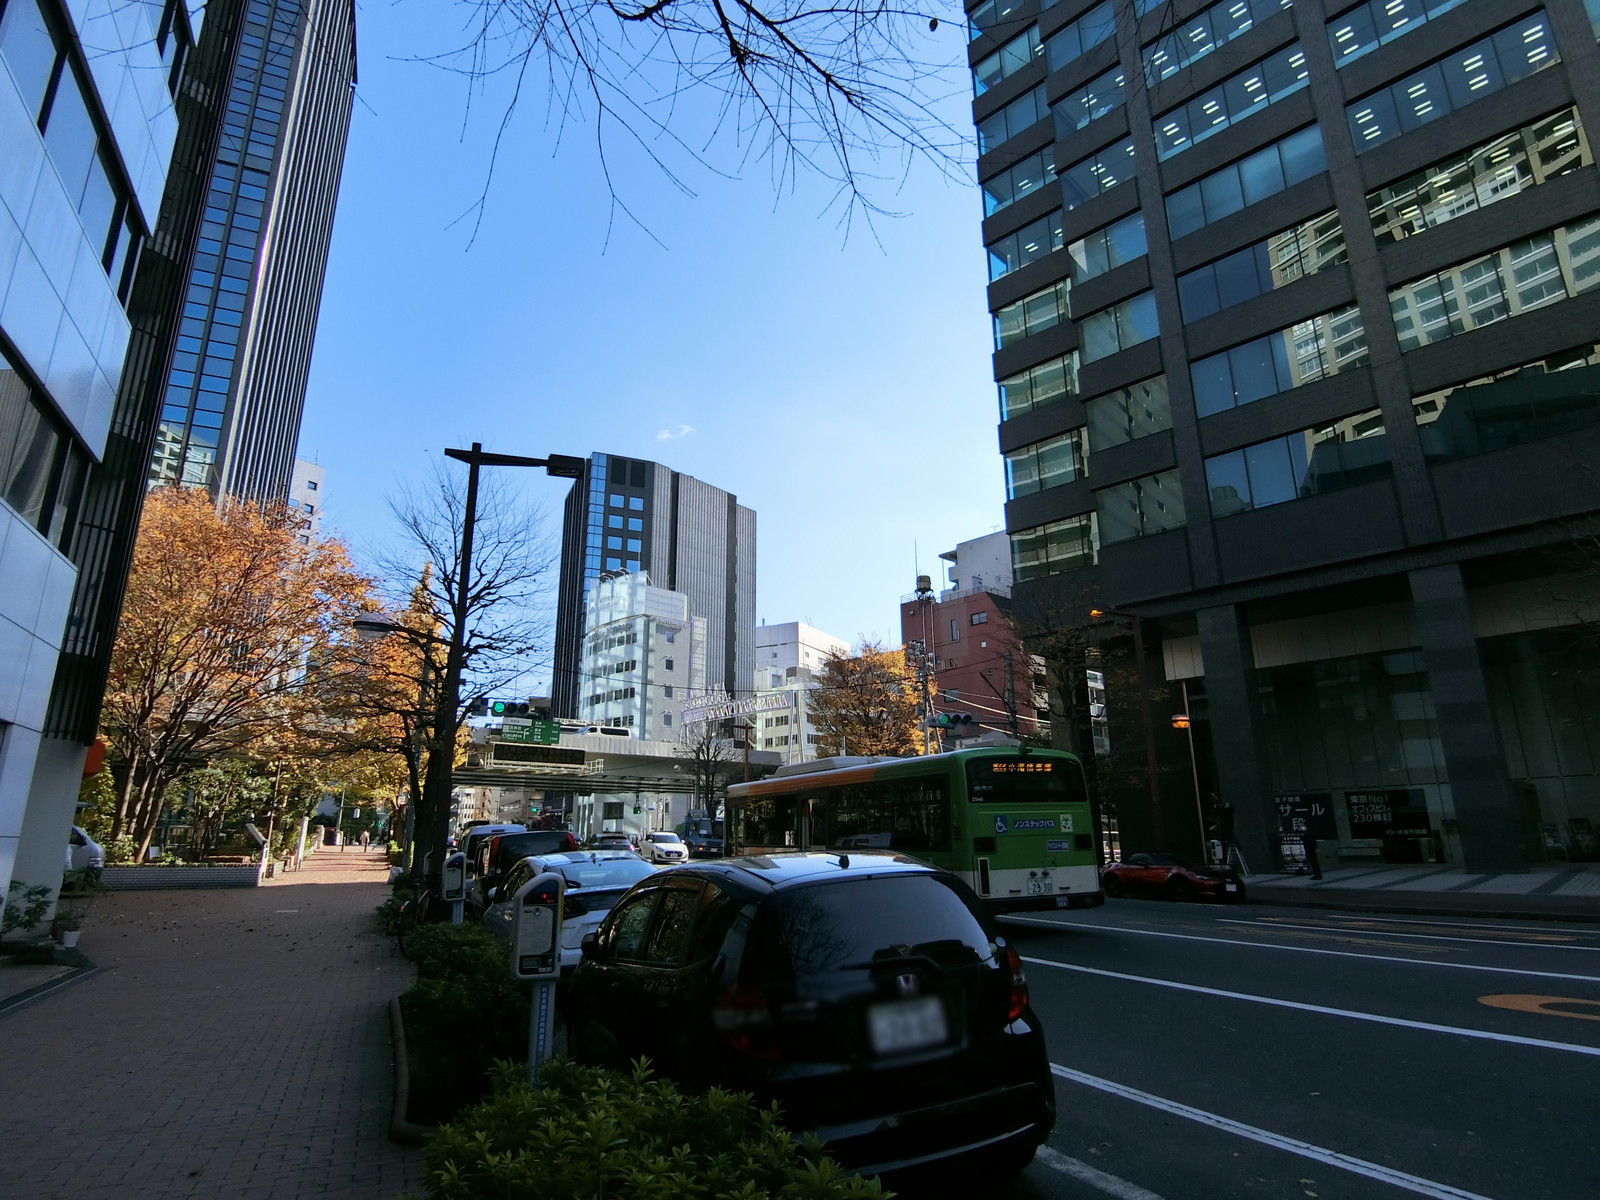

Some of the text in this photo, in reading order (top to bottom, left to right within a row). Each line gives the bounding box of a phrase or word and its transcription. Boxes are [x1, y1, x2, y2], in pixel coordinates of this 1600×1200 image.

[1278, 803, 1325, 817] サール
[1014, 819, 1056, 828] ノンステップバス
